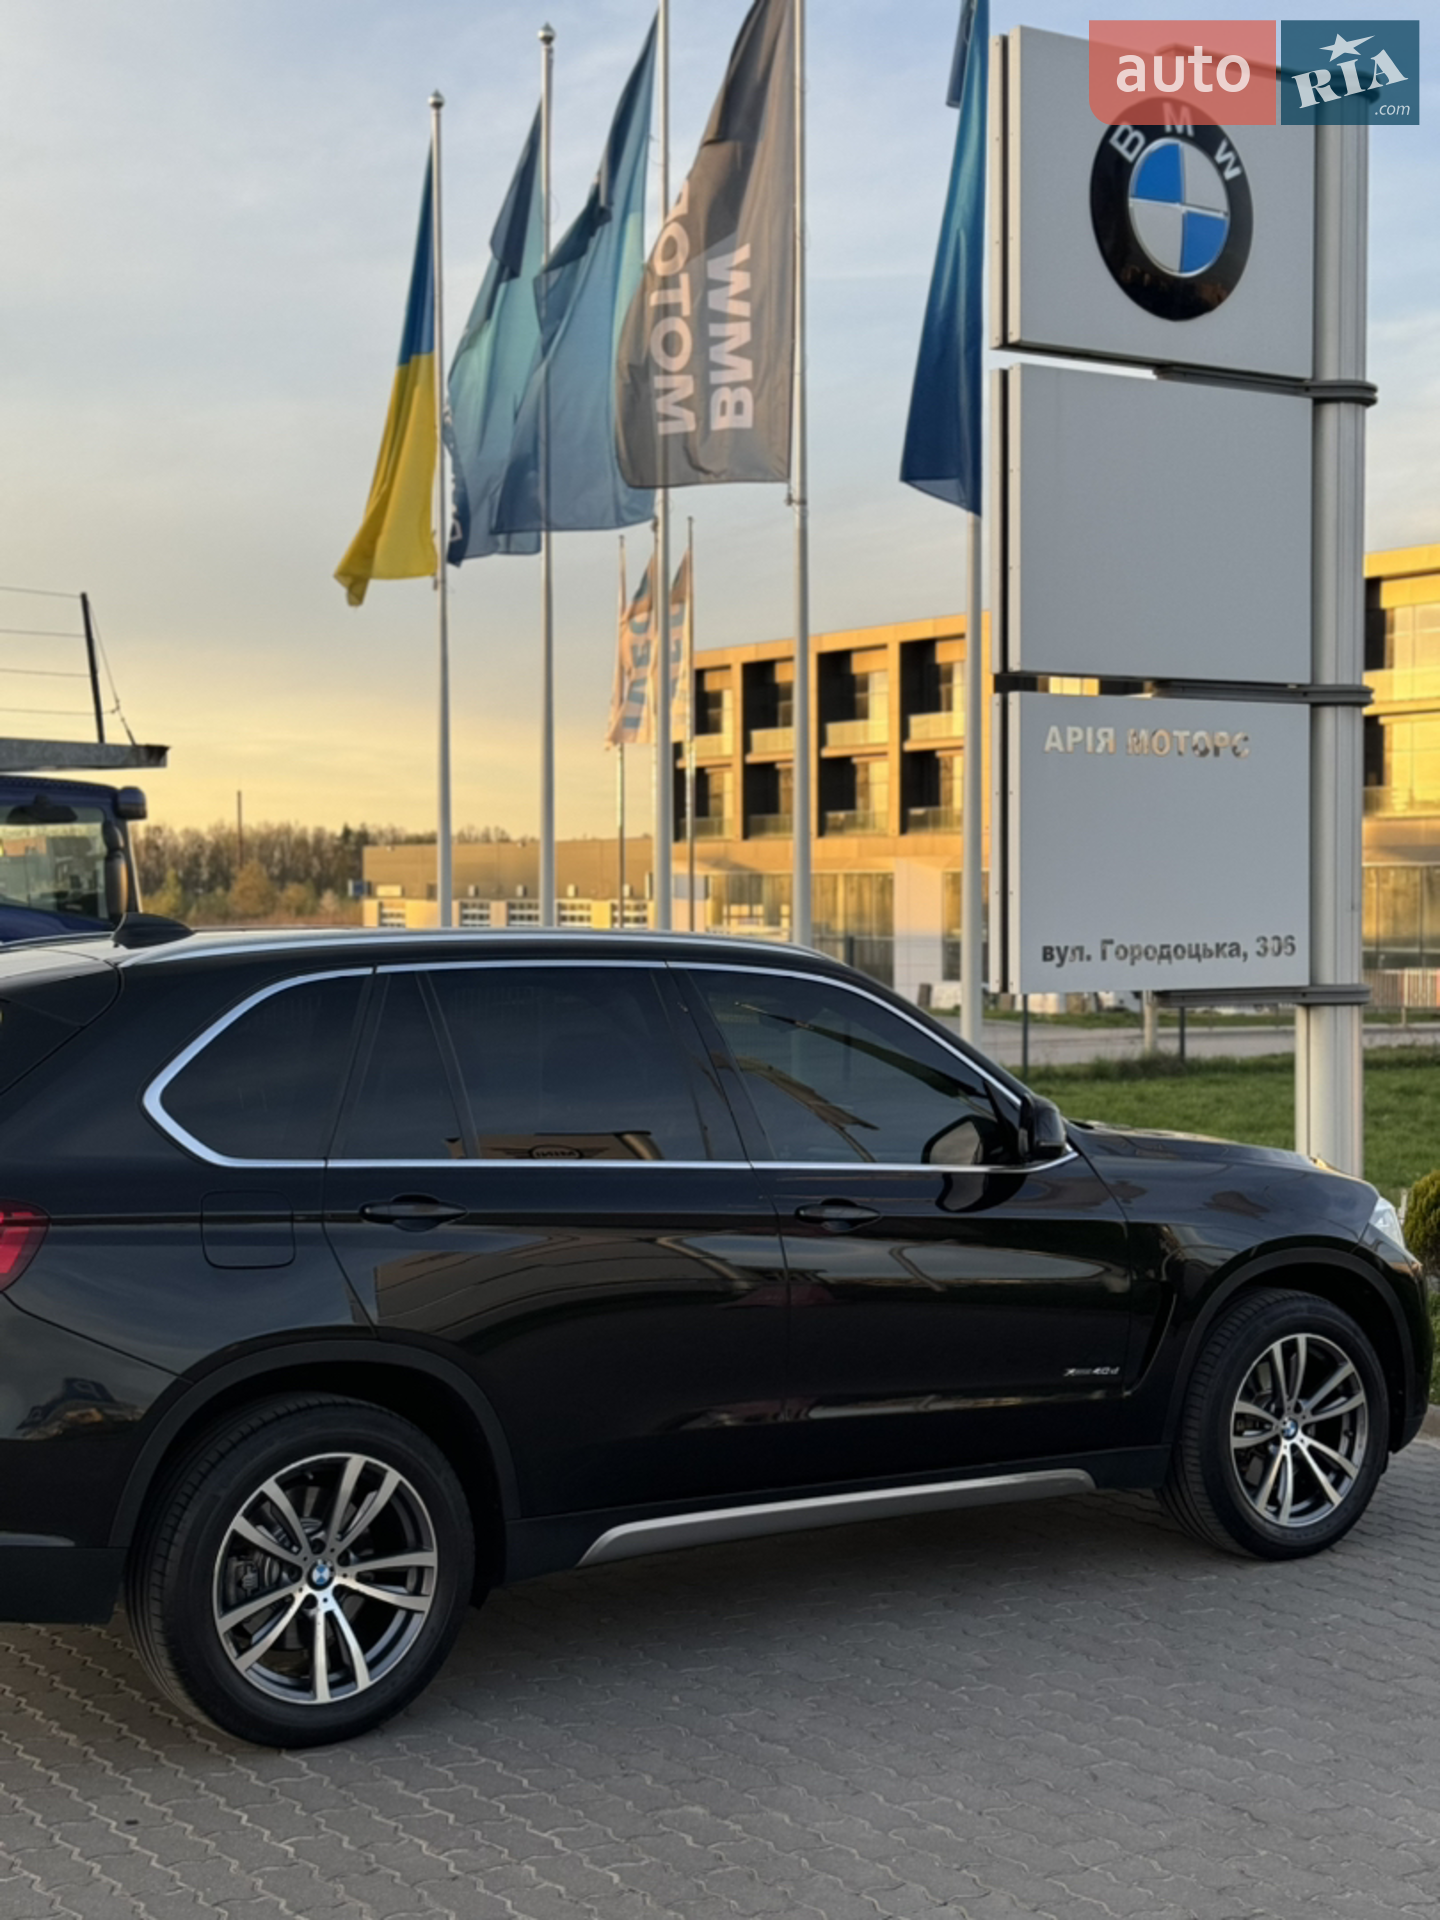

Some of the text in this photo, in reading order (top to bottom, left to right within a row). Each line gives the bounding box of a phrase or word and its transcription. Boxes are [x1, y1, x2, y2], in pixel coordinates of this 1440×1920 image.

[1109, 102, 1242, 181] BMW
[1044, 726, 1250, 759] АРІЯ МОТОРС
[1041, 935, 1297, 968] вул. Городоцька, 306
